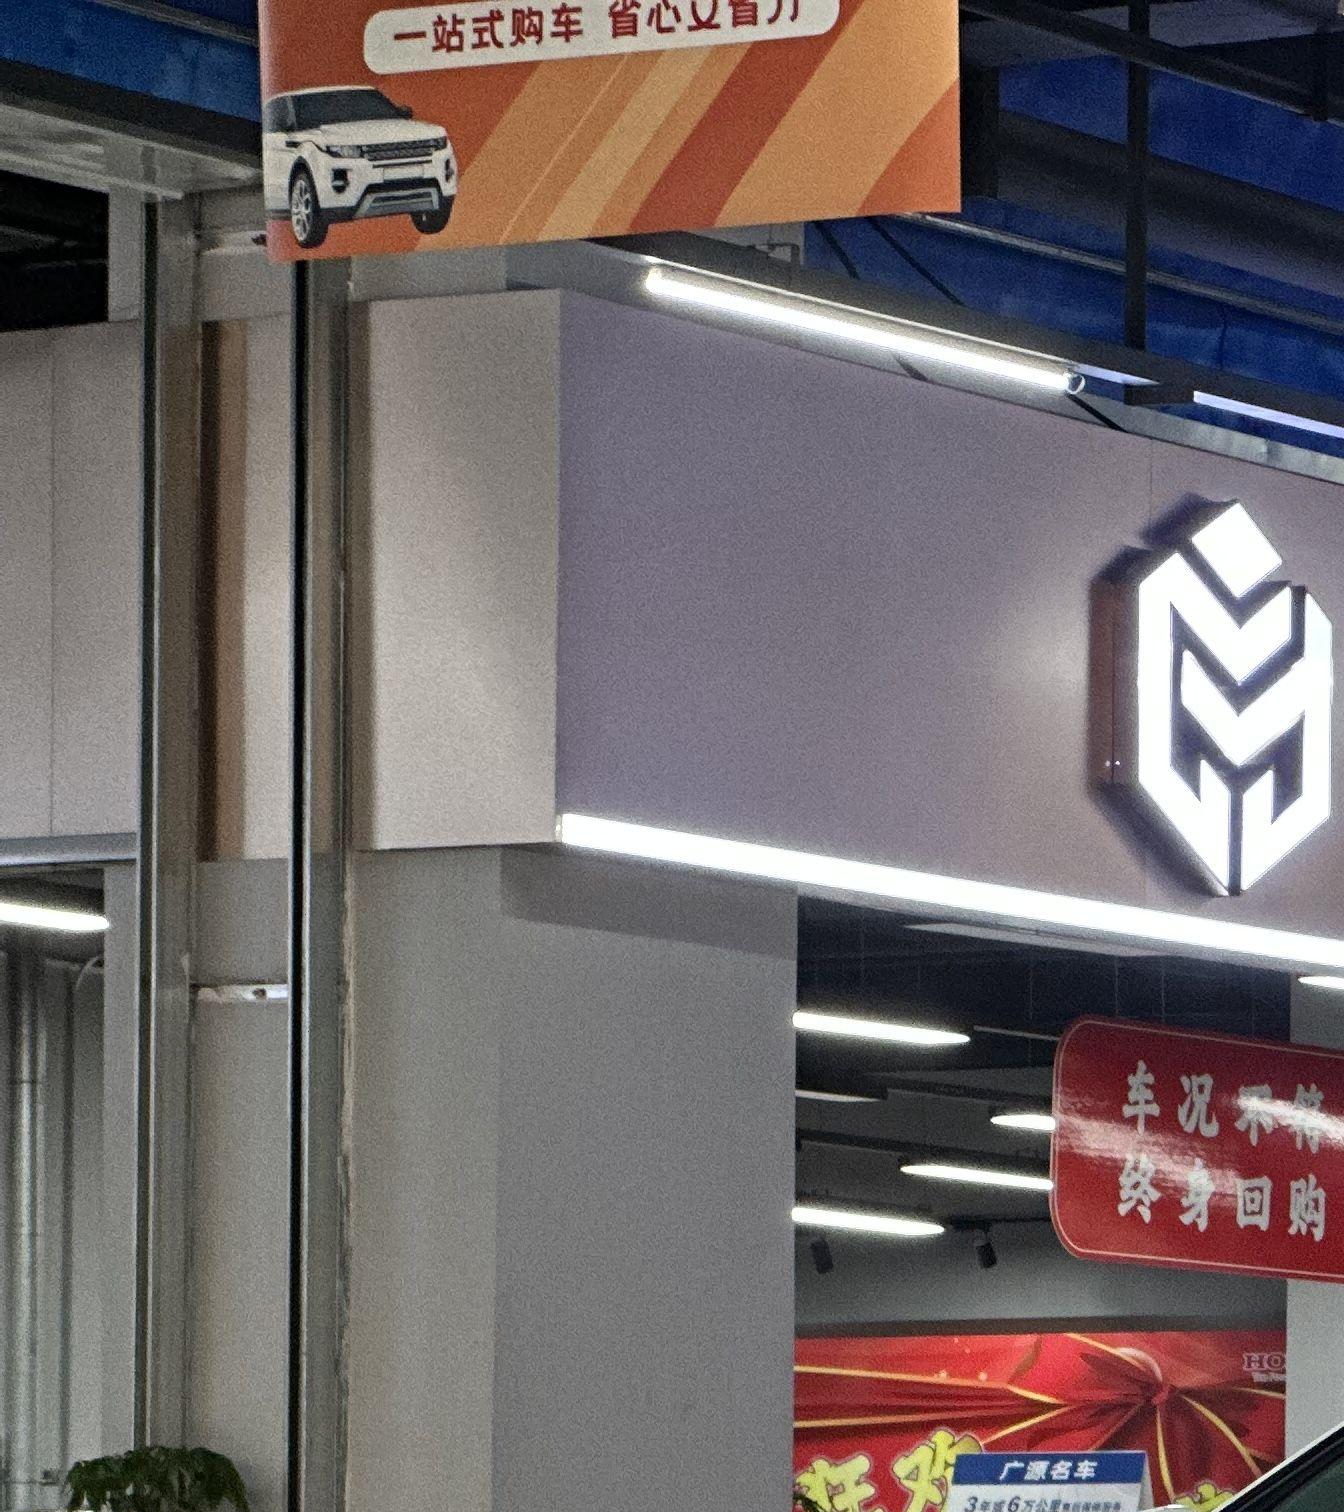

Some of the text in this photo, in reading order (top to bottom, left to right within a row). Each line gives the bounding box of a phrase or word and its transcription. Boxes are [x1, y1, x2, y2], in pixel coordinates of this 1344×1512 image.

[393, 2, 584, 54] 一站式购车
[1116, 1154, 1328, 1243] 终身回购
[999, 1459, 1099, 1481] 广源名车
